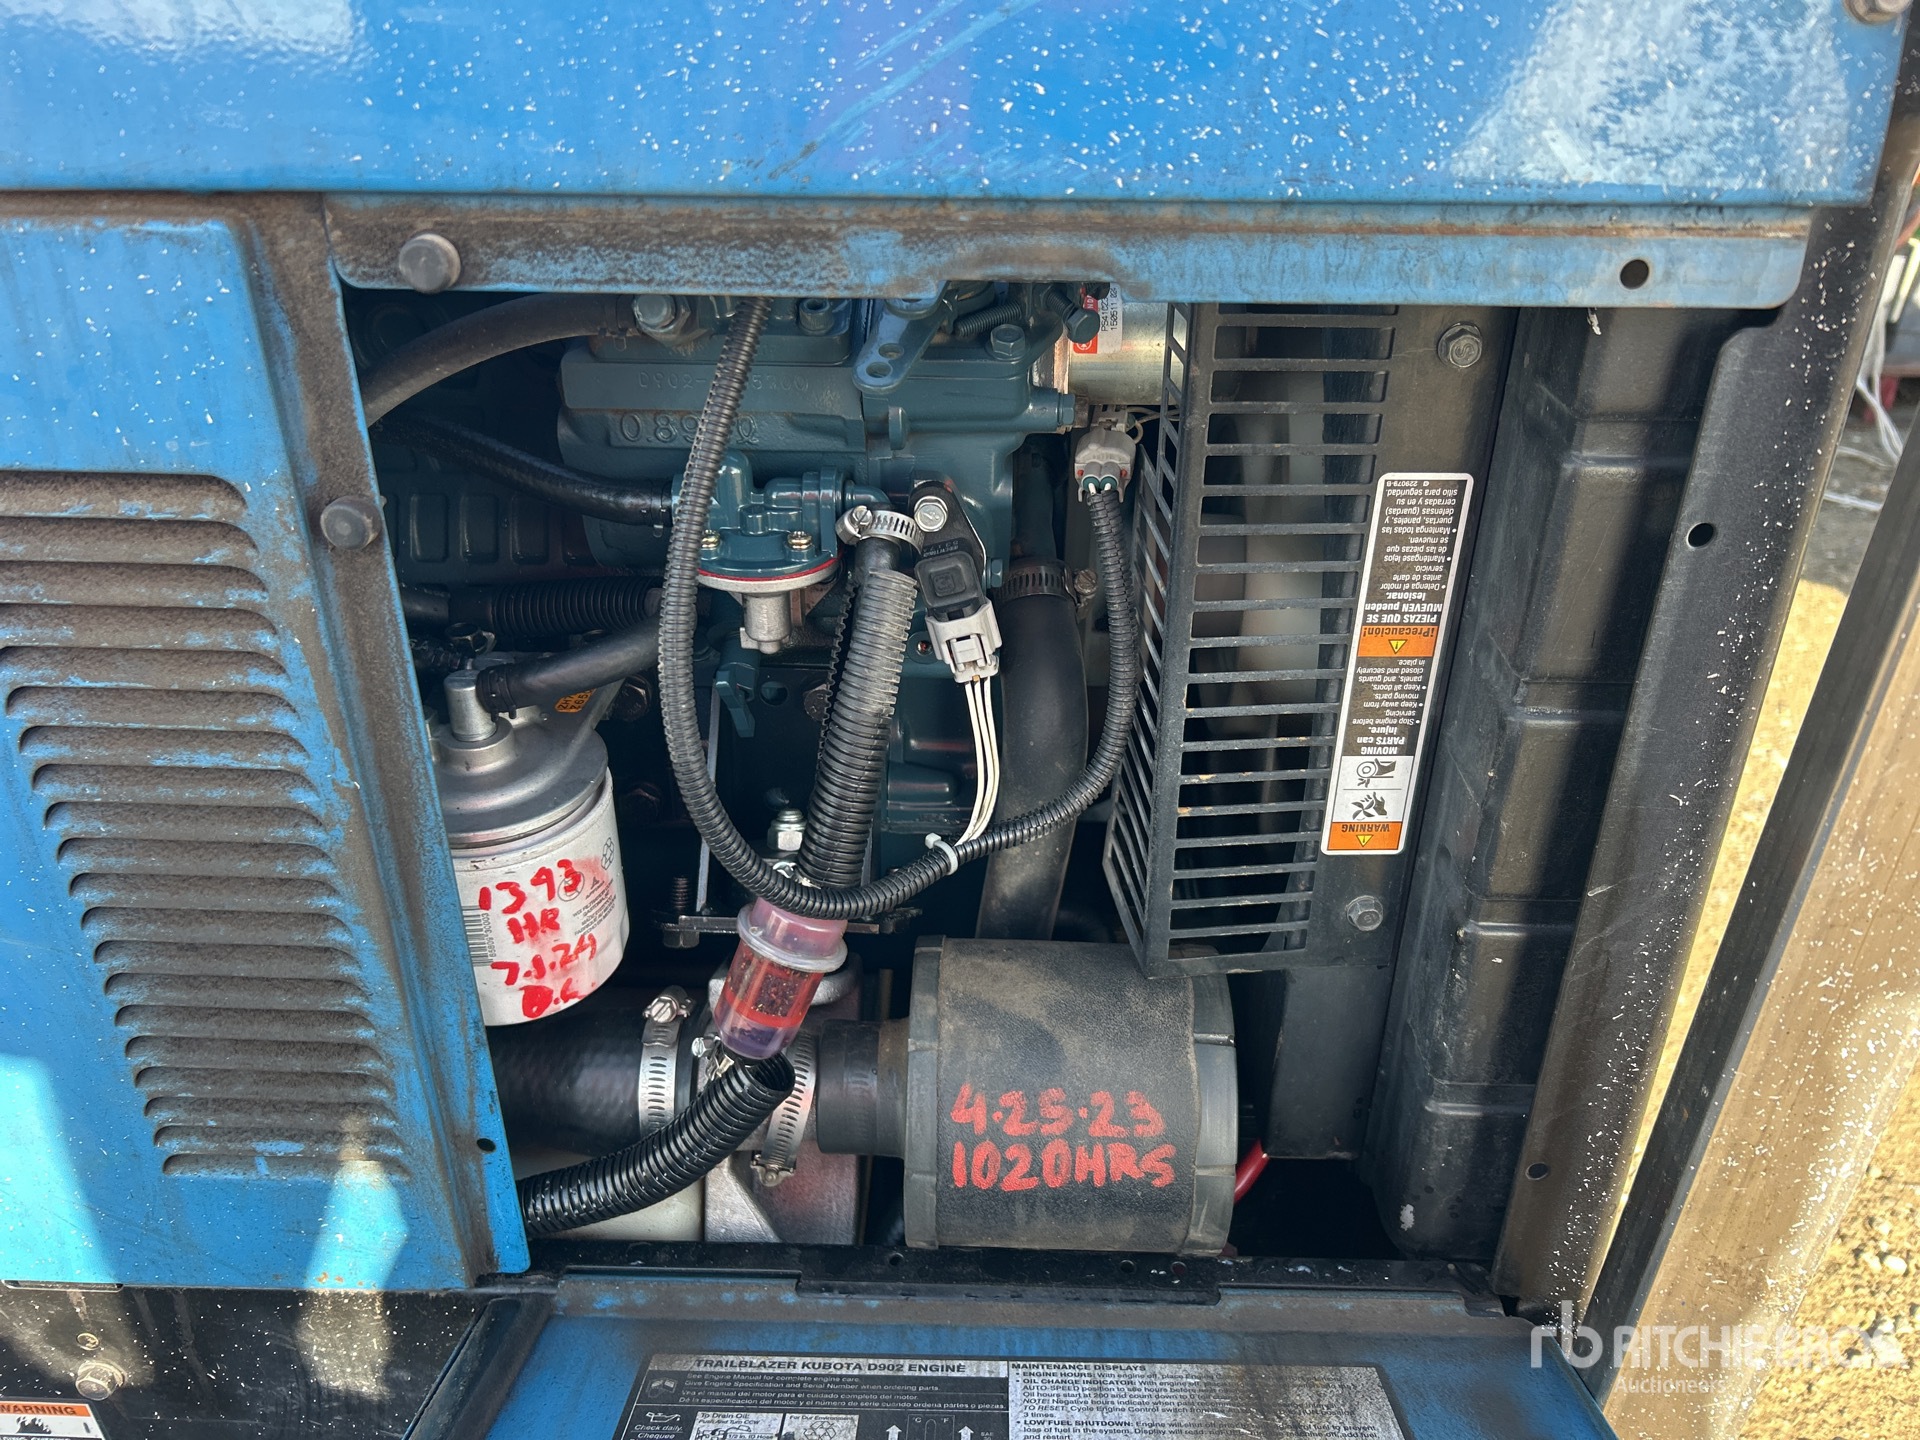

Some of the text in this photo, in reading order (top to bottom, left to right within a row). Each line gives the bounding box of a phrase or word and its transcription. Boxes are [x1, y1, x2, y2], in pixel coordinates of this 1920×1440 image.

[1386, 507, 1419, 515] (guardas)
[1392, 516, 1421, 524] paneles,
[1423, 516, 1453, 524] puertas,
[1416, 526, 1450, 534] Mantenga
[1402, 545, 1424, 553] piezas
[1384, 554, 1445, 563] Manténgase lejos
[1412, 582, 1440, 590] Detenga
[1386, 592, 1426, 601] lesionar.
[1365, 602, 1442, 612] MUEVEN pueden
[1366, 613, 1437, 623] PIEZAS QUE SE
[1363, 627, 1435, 637] ¡Precaución!
[1397, 658, 1417, 666] place.
[1356, 666, 1385, 674] securely
[1399, 675, 1422, 683] panels,
[1374, 692, 1419, 700] moving parts.
[1376, 736, 1405, 744] PARTS
[1341, 824, 1389, 832] WARNING
[479, 859, 581, 914] 1393
[695, 1359, 966, 1373] TRAILBLAZER KUBOTA D902 ENGINE
[1011, 1363, 1093, 1371] MAINTENANCE
[0, 1404, 76, 1416] WARNING
